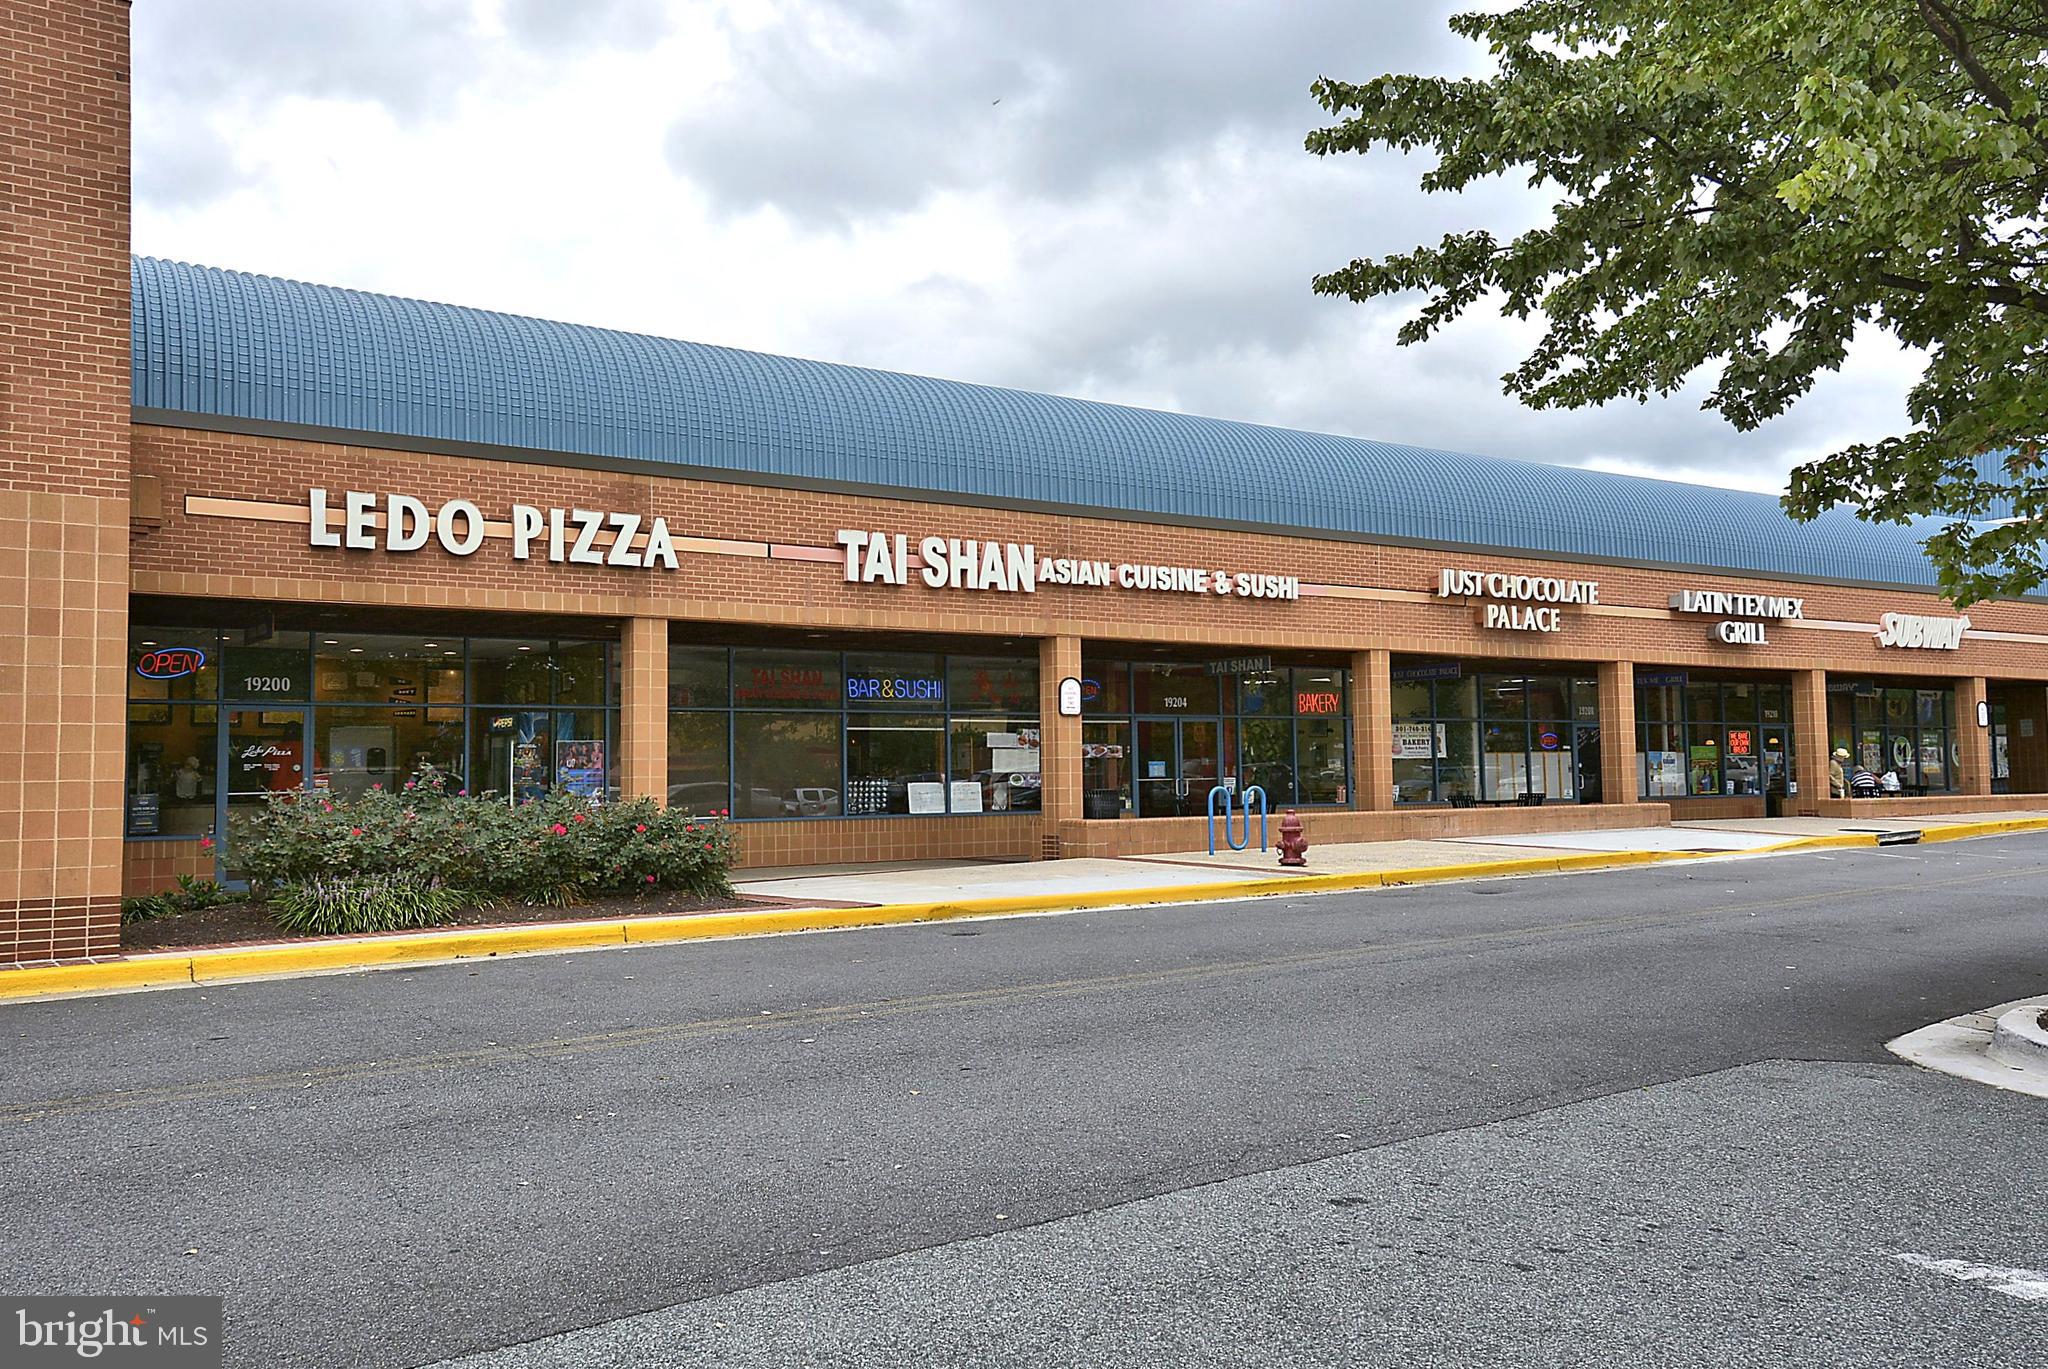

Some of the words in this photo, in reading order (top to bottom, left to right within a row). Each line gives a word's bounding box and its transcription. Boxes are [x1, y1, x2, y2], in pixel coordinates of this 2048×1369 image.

[309, 487, 485, 556] LEDO
[511, 503, 680, 570] PIZZA
[836, 529, 908, 585] TAI
[919, 535, 1036, 593] SHAN
[1038, 557, 1111, 587] ASIAN
[1116, 563, 1208, 593] CUISINE
[1211, 570, 1232, 595] &
[1234, 572, 1299, 600] SUSHI
[1438, 568, 1485, 598] JUST
[1486, 573, 1600, 604] CHOCOLATE
[1680, 589, 1733, 615] LATIN
[1733, 593, 1767, 617] TEX
[1768, 596, 1804, 619] MEX
[1484, 604, 1561, 632] PALACE
[1874, 611, 1972, 650] SUBWAY
[1717, 620, 1770, 645] GRILL
[139, 652, 200, 673] OPEN
[1209, 660, 1228, 674] TAI
[1230, 657, 1264, 672] SHAN
[244, 677, 291, 691] 19200
[1163, 697, 1188, 708] 19204
[1297, 693, 1340, 713] BAKERY
